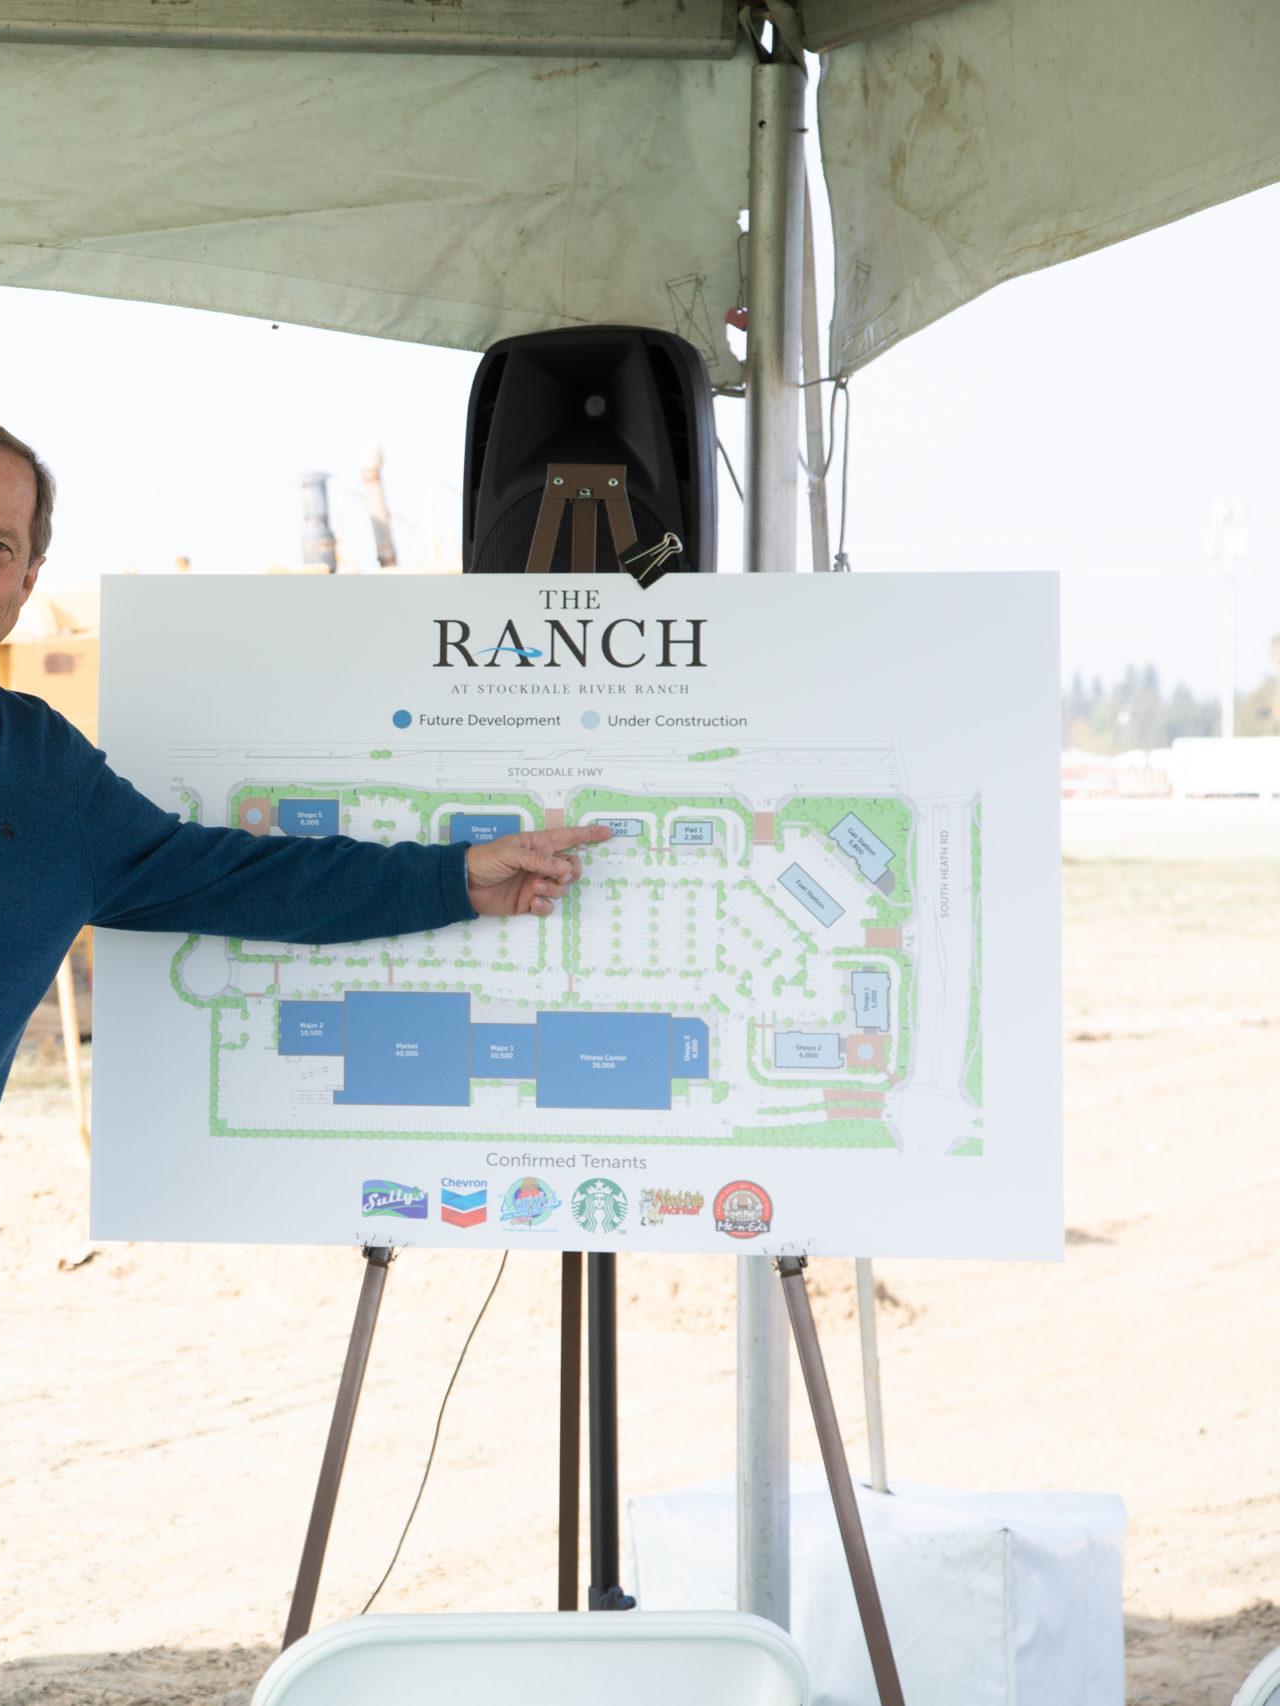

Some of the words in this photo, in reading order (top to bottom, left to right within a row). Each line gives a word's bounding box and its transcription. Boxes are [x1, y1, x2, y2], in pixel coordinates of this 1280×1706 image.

[539, 589, 601, 610] THE
[432, 618, 708, 668] RANCH
[451, 684, 470, 695] AT
[477, 684, 571, 695] STOCKDALE
[579, 684, 627, 695] RIVER
[635, 684, 690, 695] RANCH
[419, 713, 464, 727] Future
[468, 713, 562, 731] Development
[607, 714, 651, 728] Under
[655, 714, 748, 728] Construction
[508, 767, 574, 778] STOCKDALE
[577, 767, 604, 778] HWY
[297, 811, 317, 819] Shops
[471, 826, 490, 834] Shops
[475, 833, 493, 841] 7,000
[940, 830, 949, 844] RD
[847, 827, 859, 840] Gas
[857, 837, 876, 857] Station
[940, 847, 949, 880] HEATH
[795, 879, 806, 892] Fuel
[806, 890, 825, 910] Station
[940, 883, 949, 918] SOUTH
[395, 1042, 419, 1050] Market
[490, 1052, 513, 1060] 10,500
[486, 1152, 576, 1168] Confirmed
[581, 1154, 647, 1169] Tenants
[440, 1177, 488, 1188] Chevron
